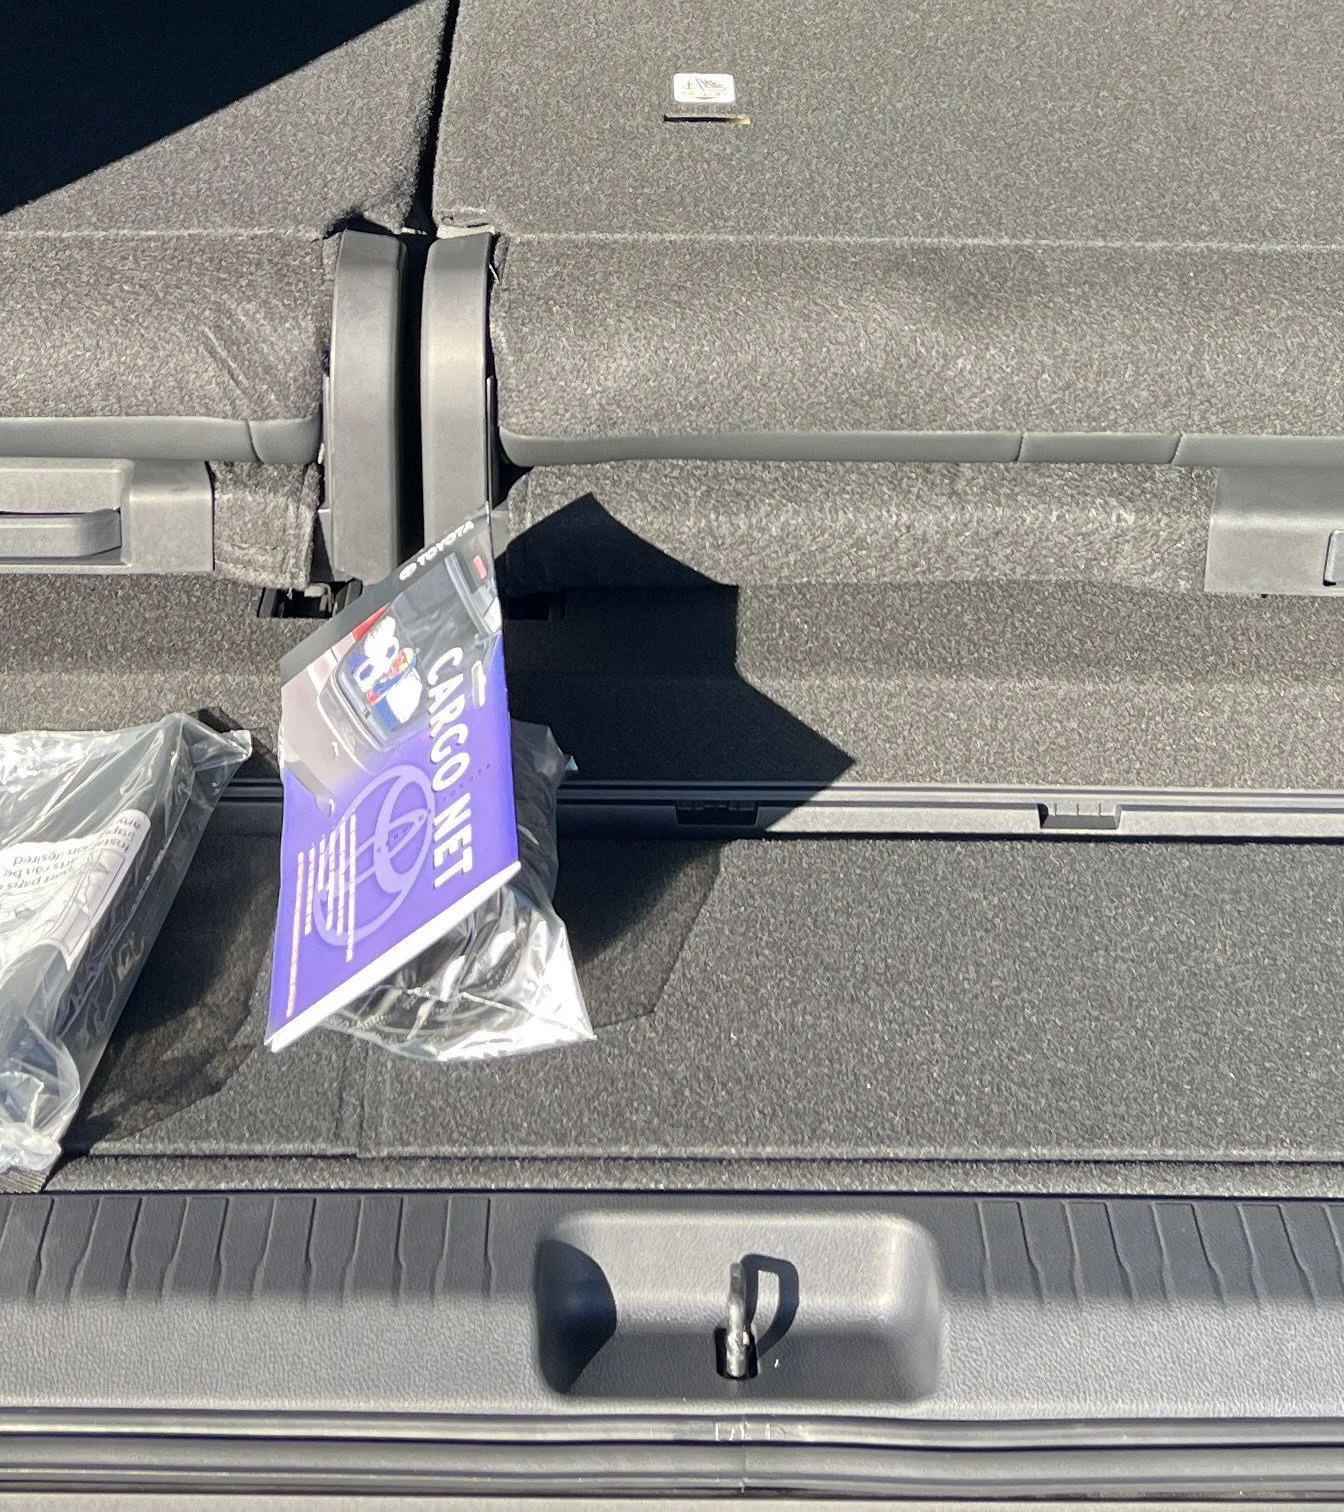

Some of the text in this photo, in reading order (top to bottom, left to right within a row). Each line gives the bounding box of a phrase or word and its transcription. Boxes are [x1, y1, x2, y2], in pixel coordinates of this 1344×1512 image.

[417, 520, 475, 566] TOYOTA
[428, 647, 473, 889] CARGO NET
